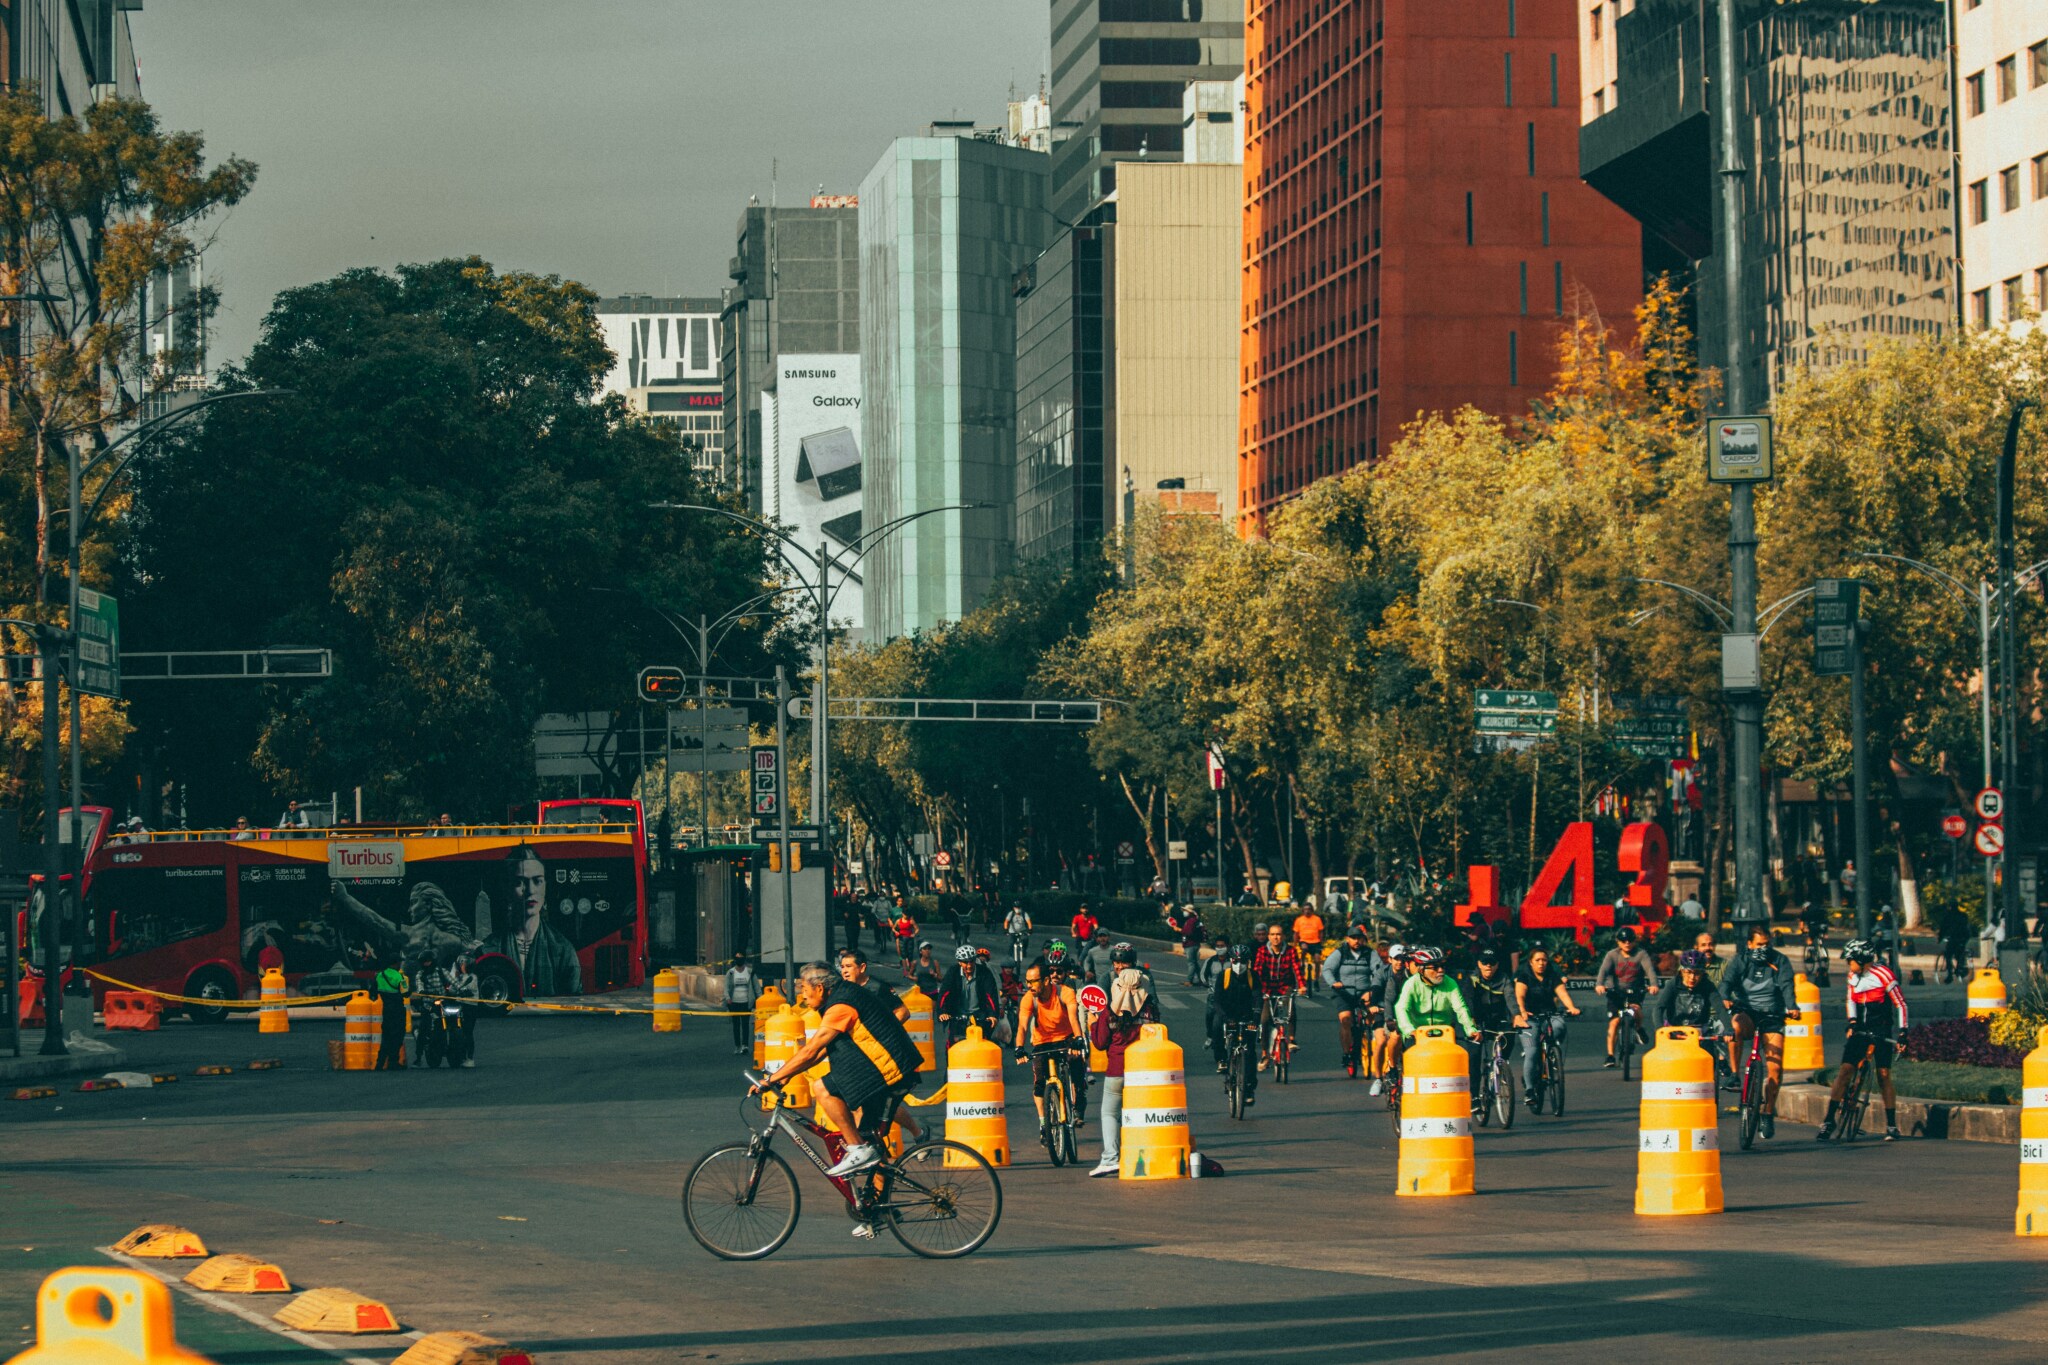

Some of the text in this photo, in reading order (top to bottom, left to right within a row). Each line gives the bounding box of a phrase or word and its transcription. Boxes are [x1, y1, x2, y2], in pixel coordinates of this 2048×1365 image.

[784, 370, 836, 379] SAMSUNG
[813, 396, 860, 409] Galaxy
[1506, 694, 1537, 705] NIZA
[338, 849, 393, 866] Turibus
[165, 869, 223, 877] turibus.com.mx
[1082, 993, 1106, 1005] ALTO
[953, 1106, 997, 1116] Muévete
[2023, 1144, 2043, 1158] Bici
